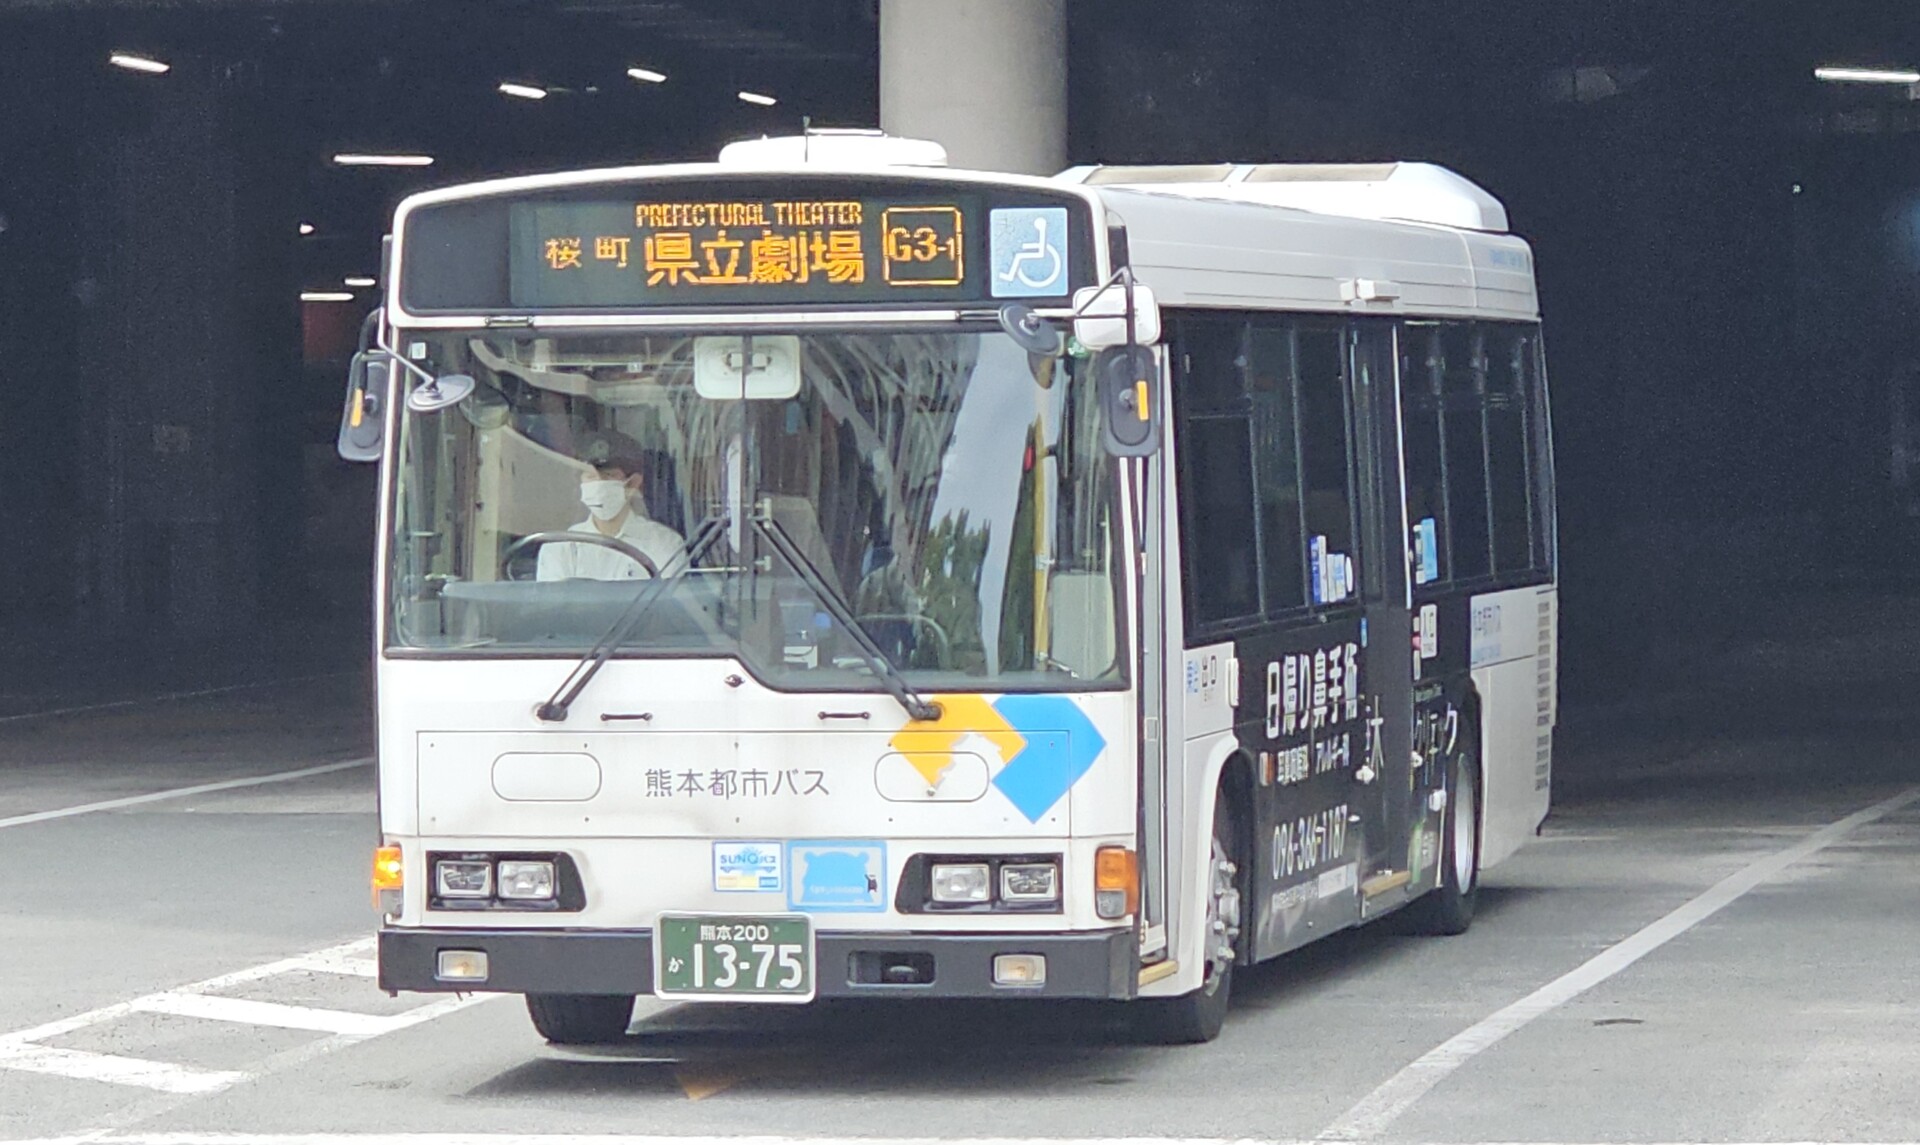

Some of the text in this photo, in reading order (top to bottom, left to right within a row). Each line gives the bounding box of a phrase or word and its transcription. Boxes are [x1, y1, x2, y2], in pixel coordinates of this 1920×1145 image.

[635, 201, 863, 228] PREFECTURAL THEATER
[644, 231, 865, 286] 県立劇場
[888, 227, 958, 263] G3-1
[644, 768, 830, 800] 熊本都市バス
[700, 924, 769, 942] 熊本200
[668, 956, 683, 973] か
[693, 943, 803, 989] 13-75
